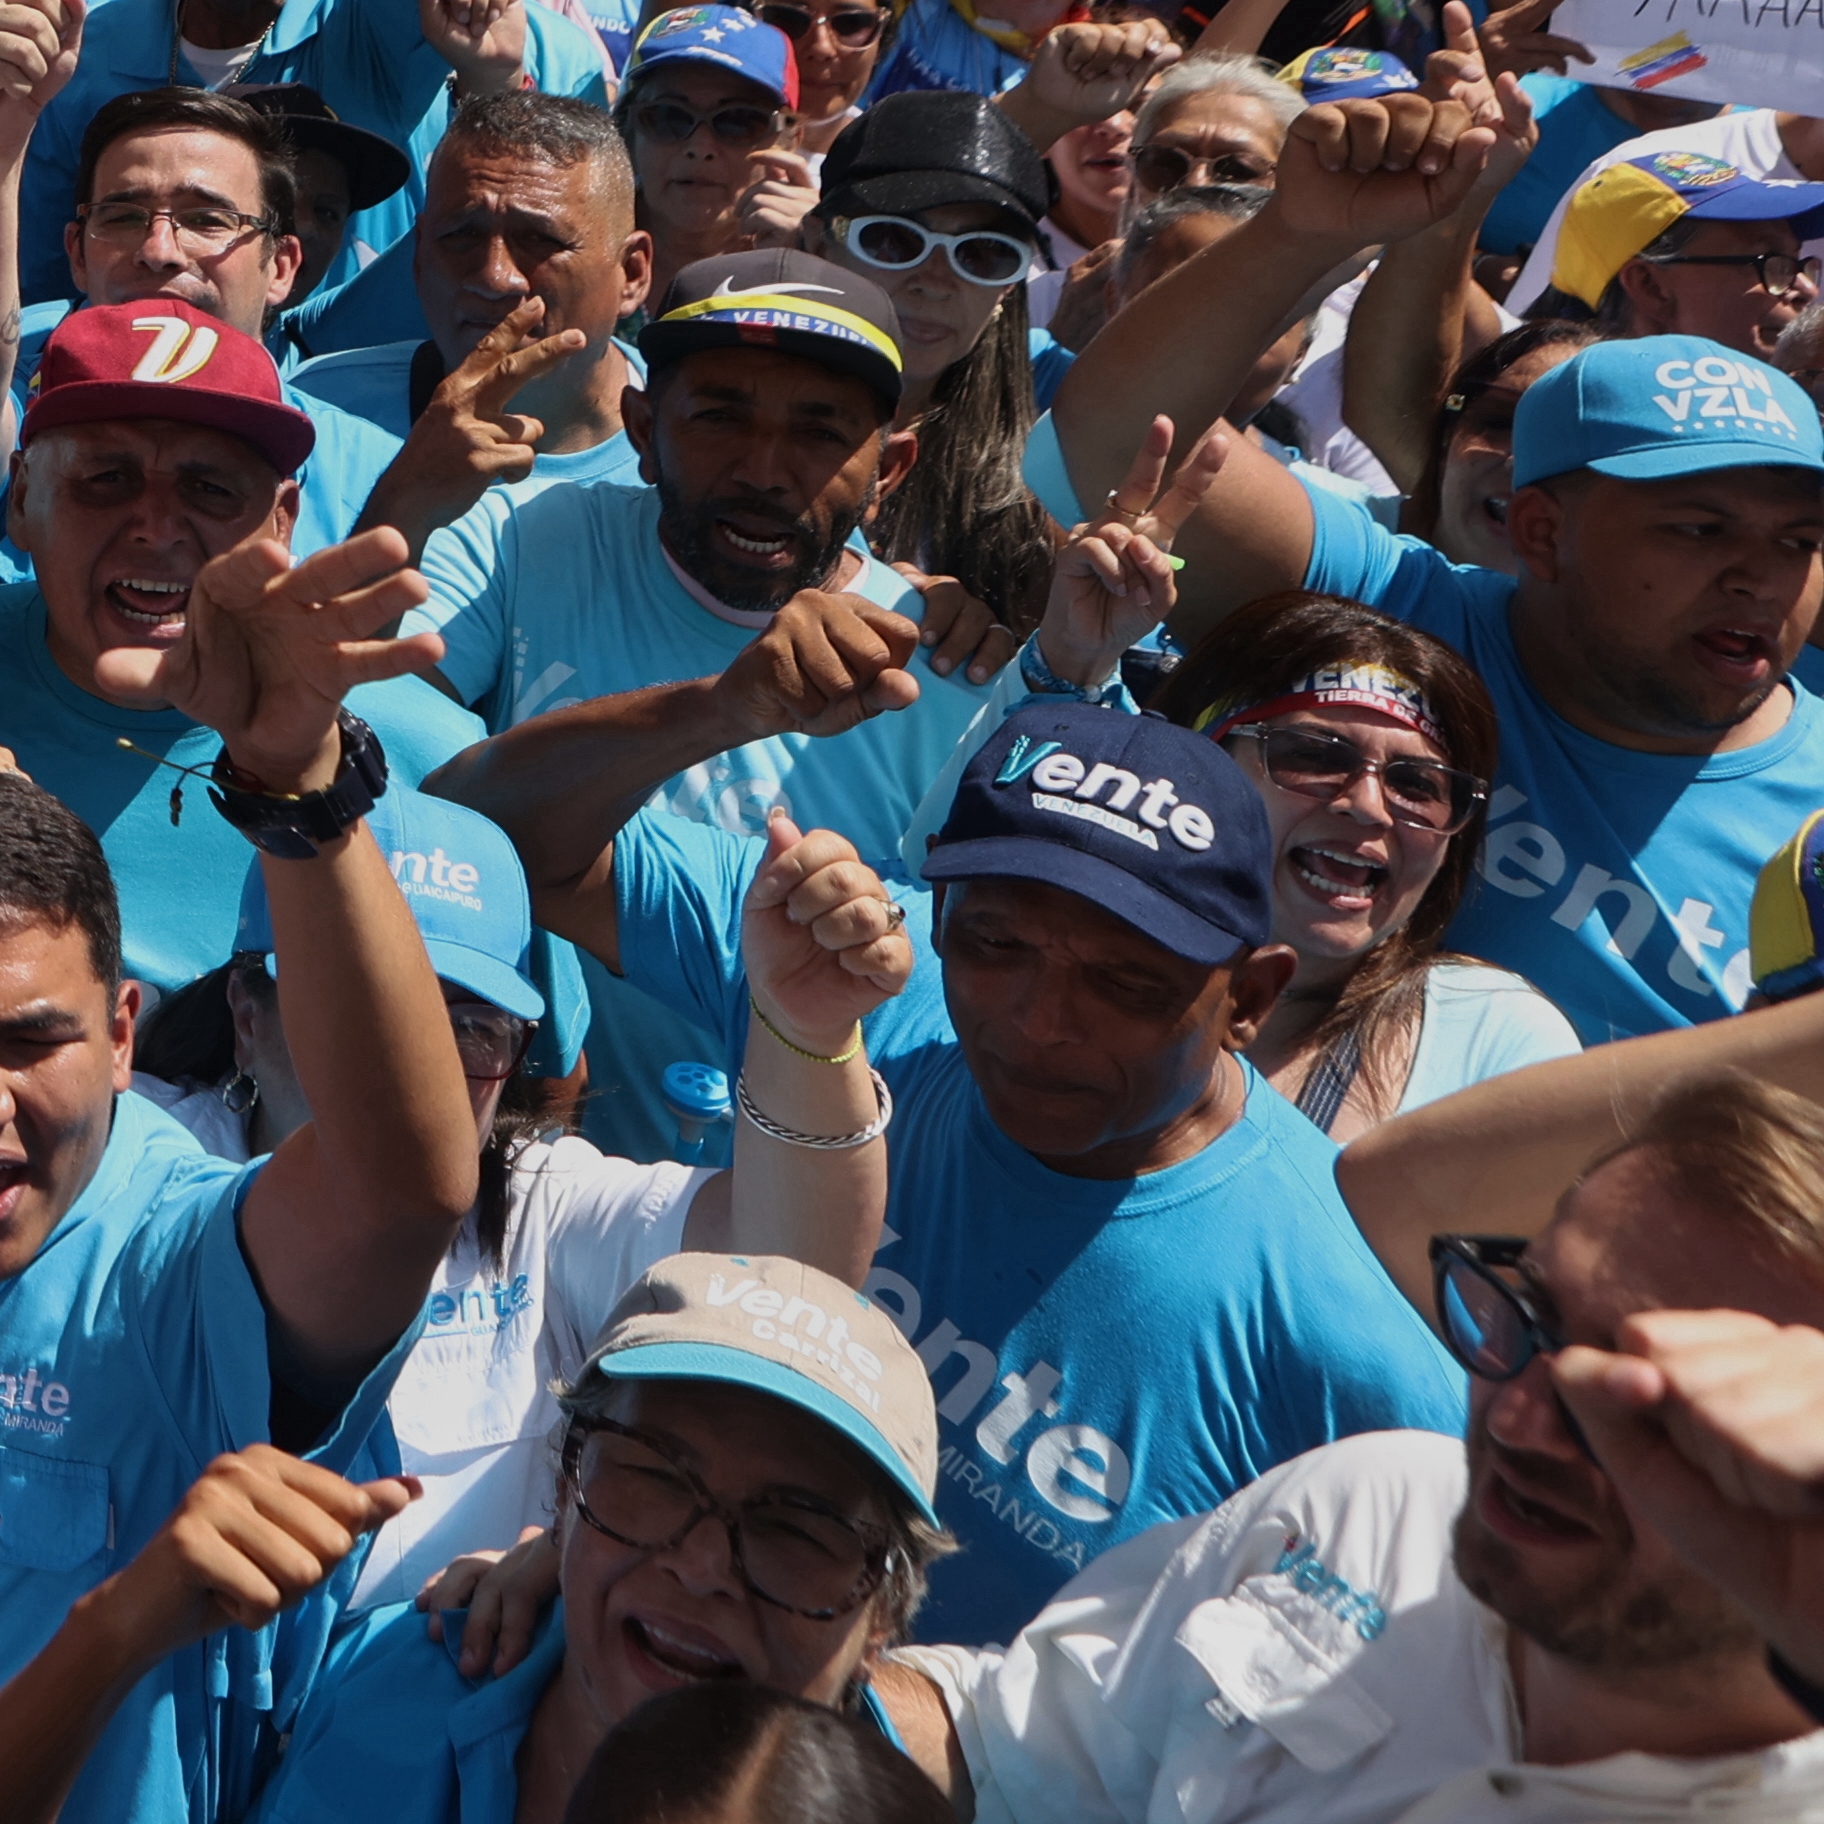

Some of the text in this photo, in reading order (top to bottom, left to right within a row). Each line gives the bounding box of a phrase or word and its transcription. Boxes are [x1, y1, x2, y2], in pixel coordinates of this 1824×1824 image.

[1655, 355, 1774, 398] CON
[1652, 386, 1798, 433] VZLA
[1314, 689, 1392, 713] TIERRA
[994, 734, 1215, 852] Vente
[1032, 792, 1160, 852] VENEZUELA
[392, 846, 480, 893] nte
[428, 1271, 531, 1326] ente
[704, 1271, 886, 1383] Vente
[750, 1316, 883, 1413] Carrizal
[3, 1413, 66, 1437] MIRANDA
